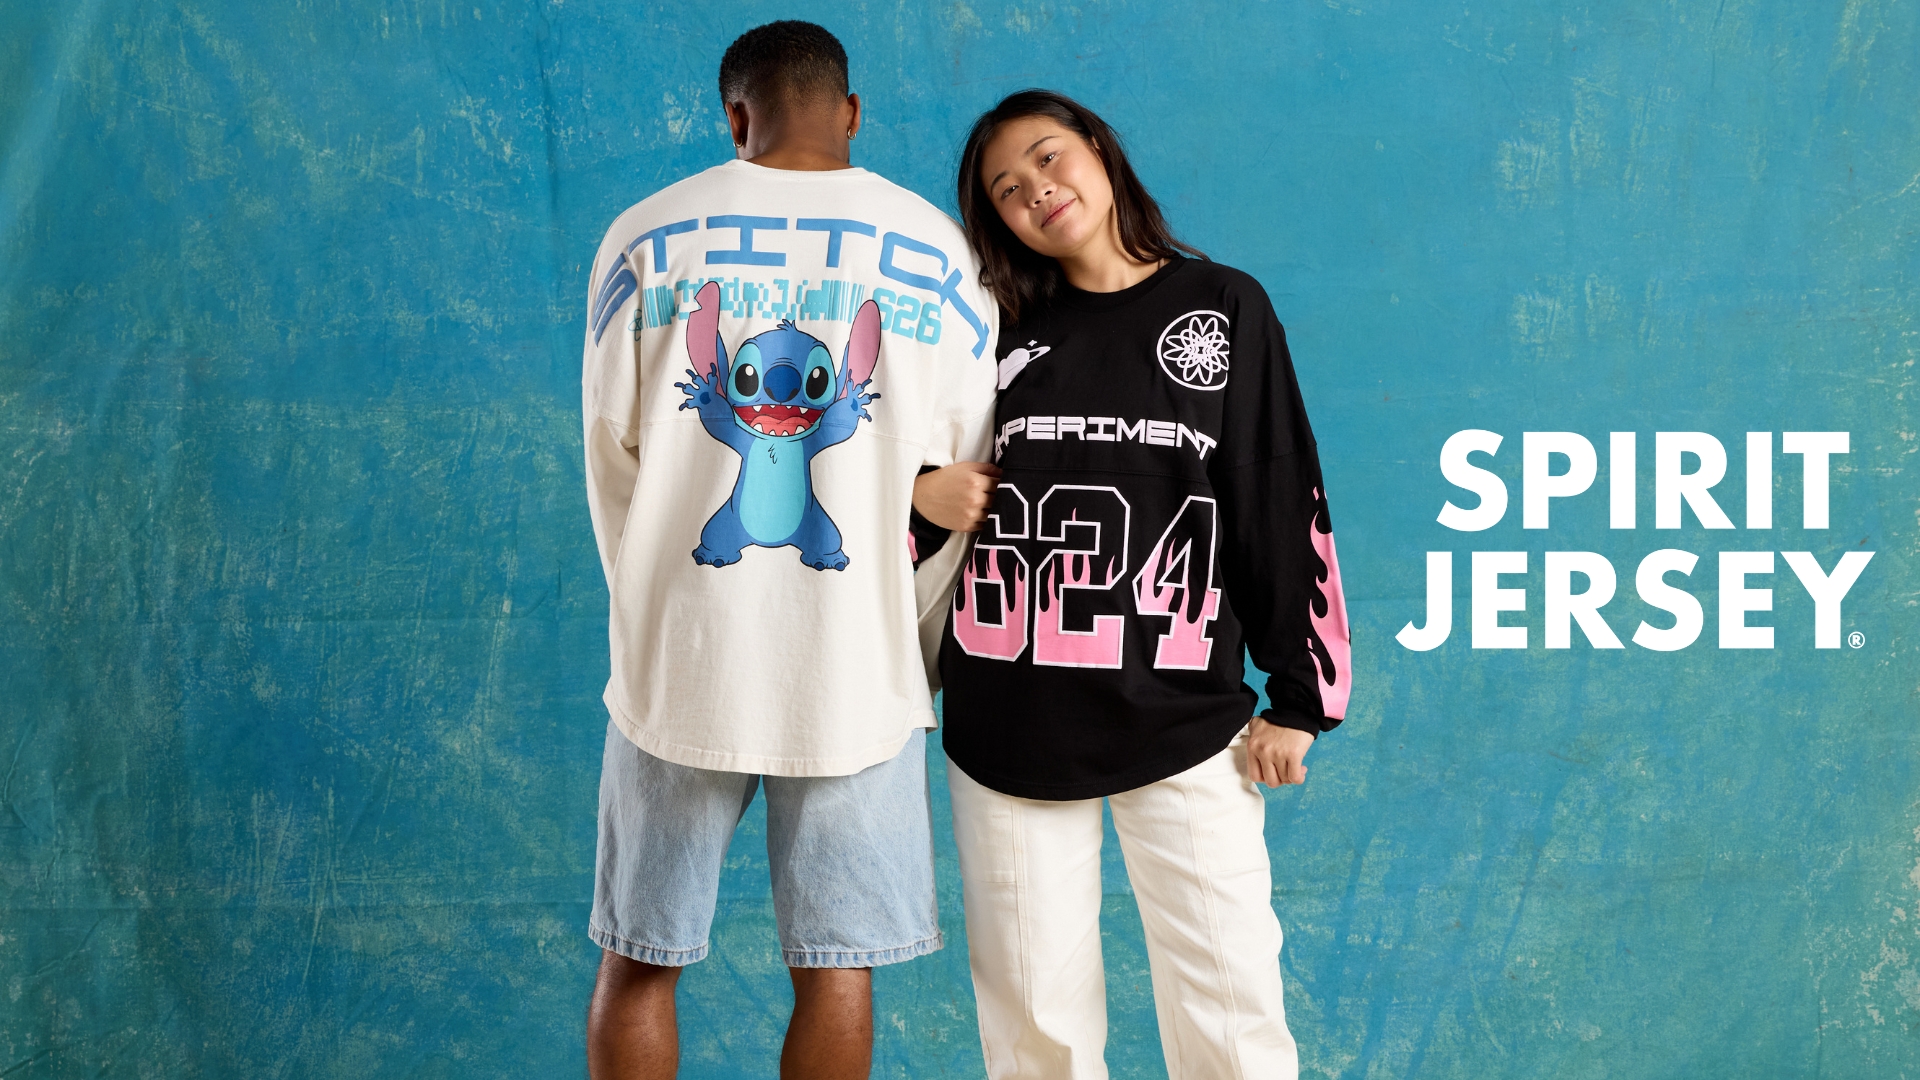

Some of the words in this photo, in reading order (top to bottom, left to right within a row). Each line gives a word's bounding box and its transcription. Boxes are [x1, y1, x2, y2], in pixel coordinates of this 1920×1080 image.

[872, 287, 942, 346] 626
[995, 416, 1217, 464] XPERIMENT
[953, 483, 1222, 671] 624
